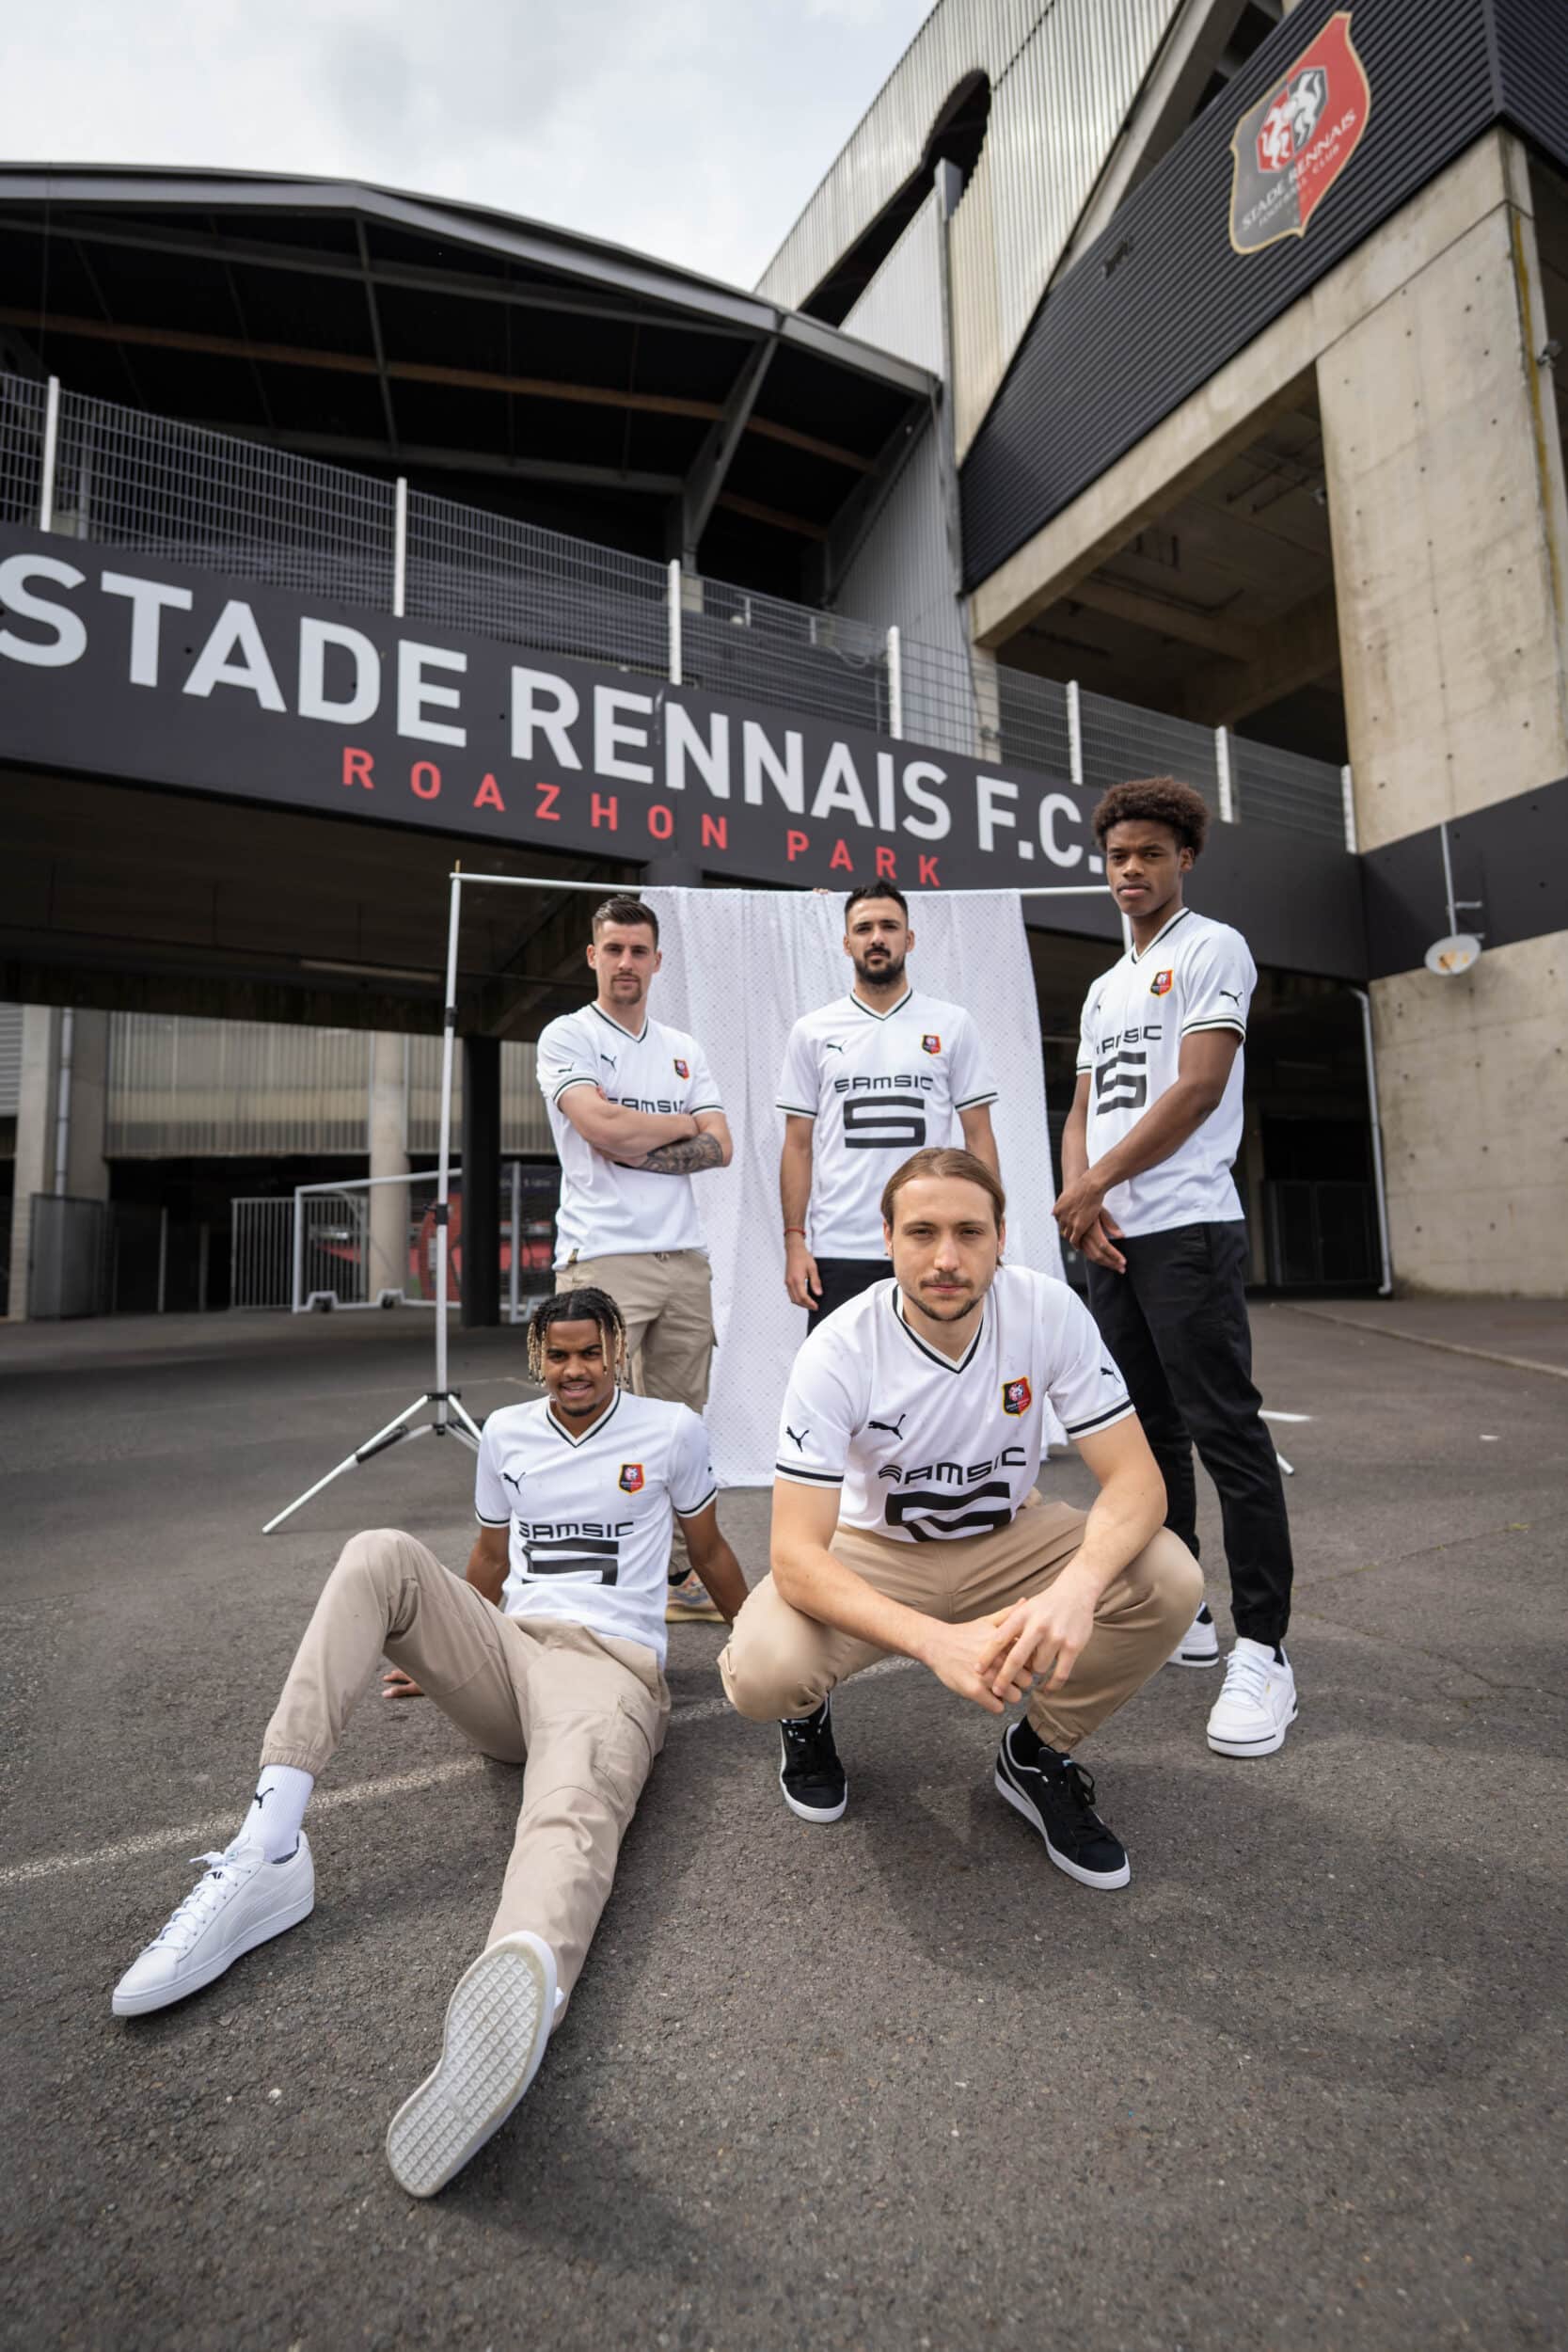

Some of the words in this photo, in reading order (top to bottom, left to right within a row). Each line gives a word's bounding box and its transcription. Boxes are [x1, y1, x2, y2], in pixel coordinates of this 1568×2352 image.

[0, 552, 467, 748] STADE
[510, 664, 952, 842] RENNAIS
[974, 774, 1103, 874] F.C.
[342, 747, 728, 850] ROAZHON
[787, 830, 942, 888] PARK
[833, 1074, 934, 1094] SAMSIC
[878, 1446, 1027, 1486] SAMSIC
[518, 1520, 635, 1540] SAMSIC
